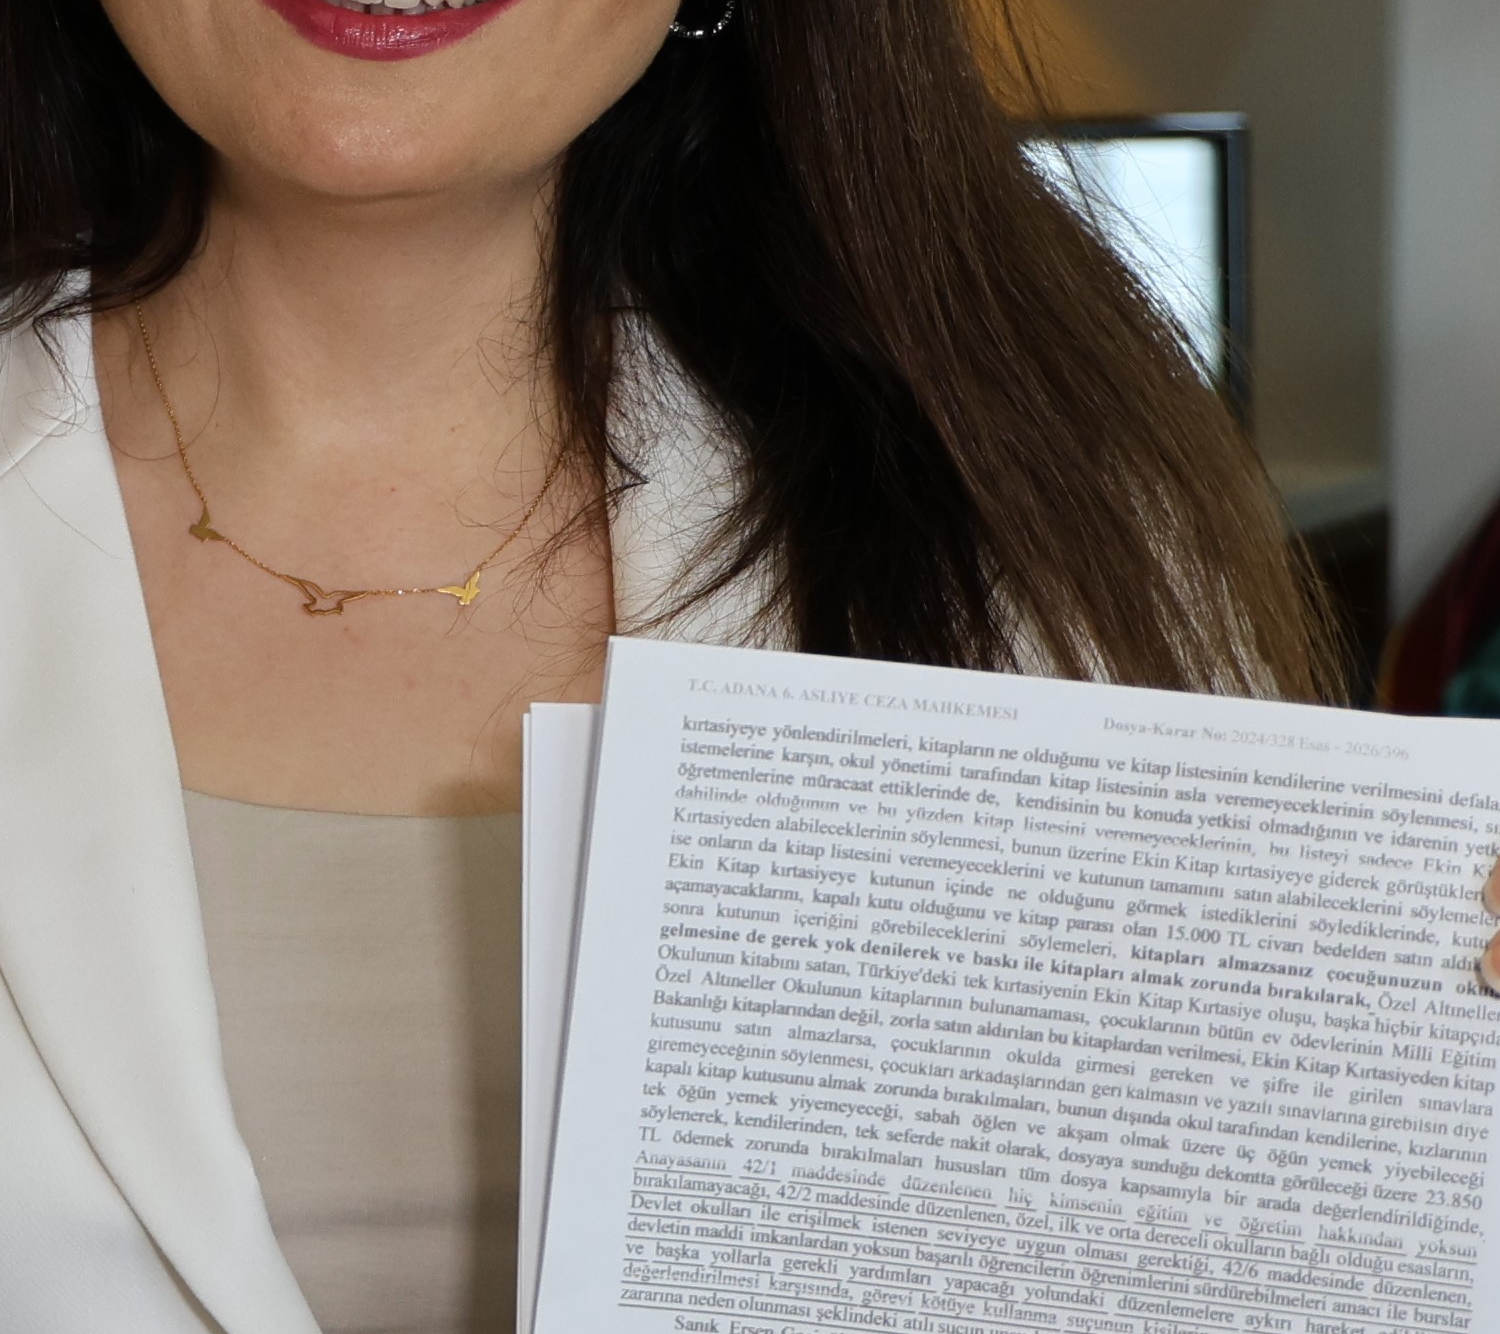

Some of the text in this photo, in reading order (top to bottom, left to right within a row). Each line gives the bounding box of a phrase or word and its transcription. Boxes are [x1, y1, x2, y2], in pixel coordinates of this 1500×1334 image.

[721, 680, 795, 700] ADANA 6.
[863, 694, 908, 711] CEZA
[682, 715, 996, 761] kırtasiyeye kitapların
[1130, 755, 1172, 778] kitap
[1176, 761, 1249, 784] listesinin
[1253, 768, 1347, 794] kendilerine
[1351, 779, 1444, 805] verilmesini
[660, 923, 941, 961] gelmesine gerek yok denilerek
[1167, 924, 1252, 949] 15.000 TL
[1190, 974, 1263, 997] zorunda
[1424, 1188, 1483, 1212] 23.850
